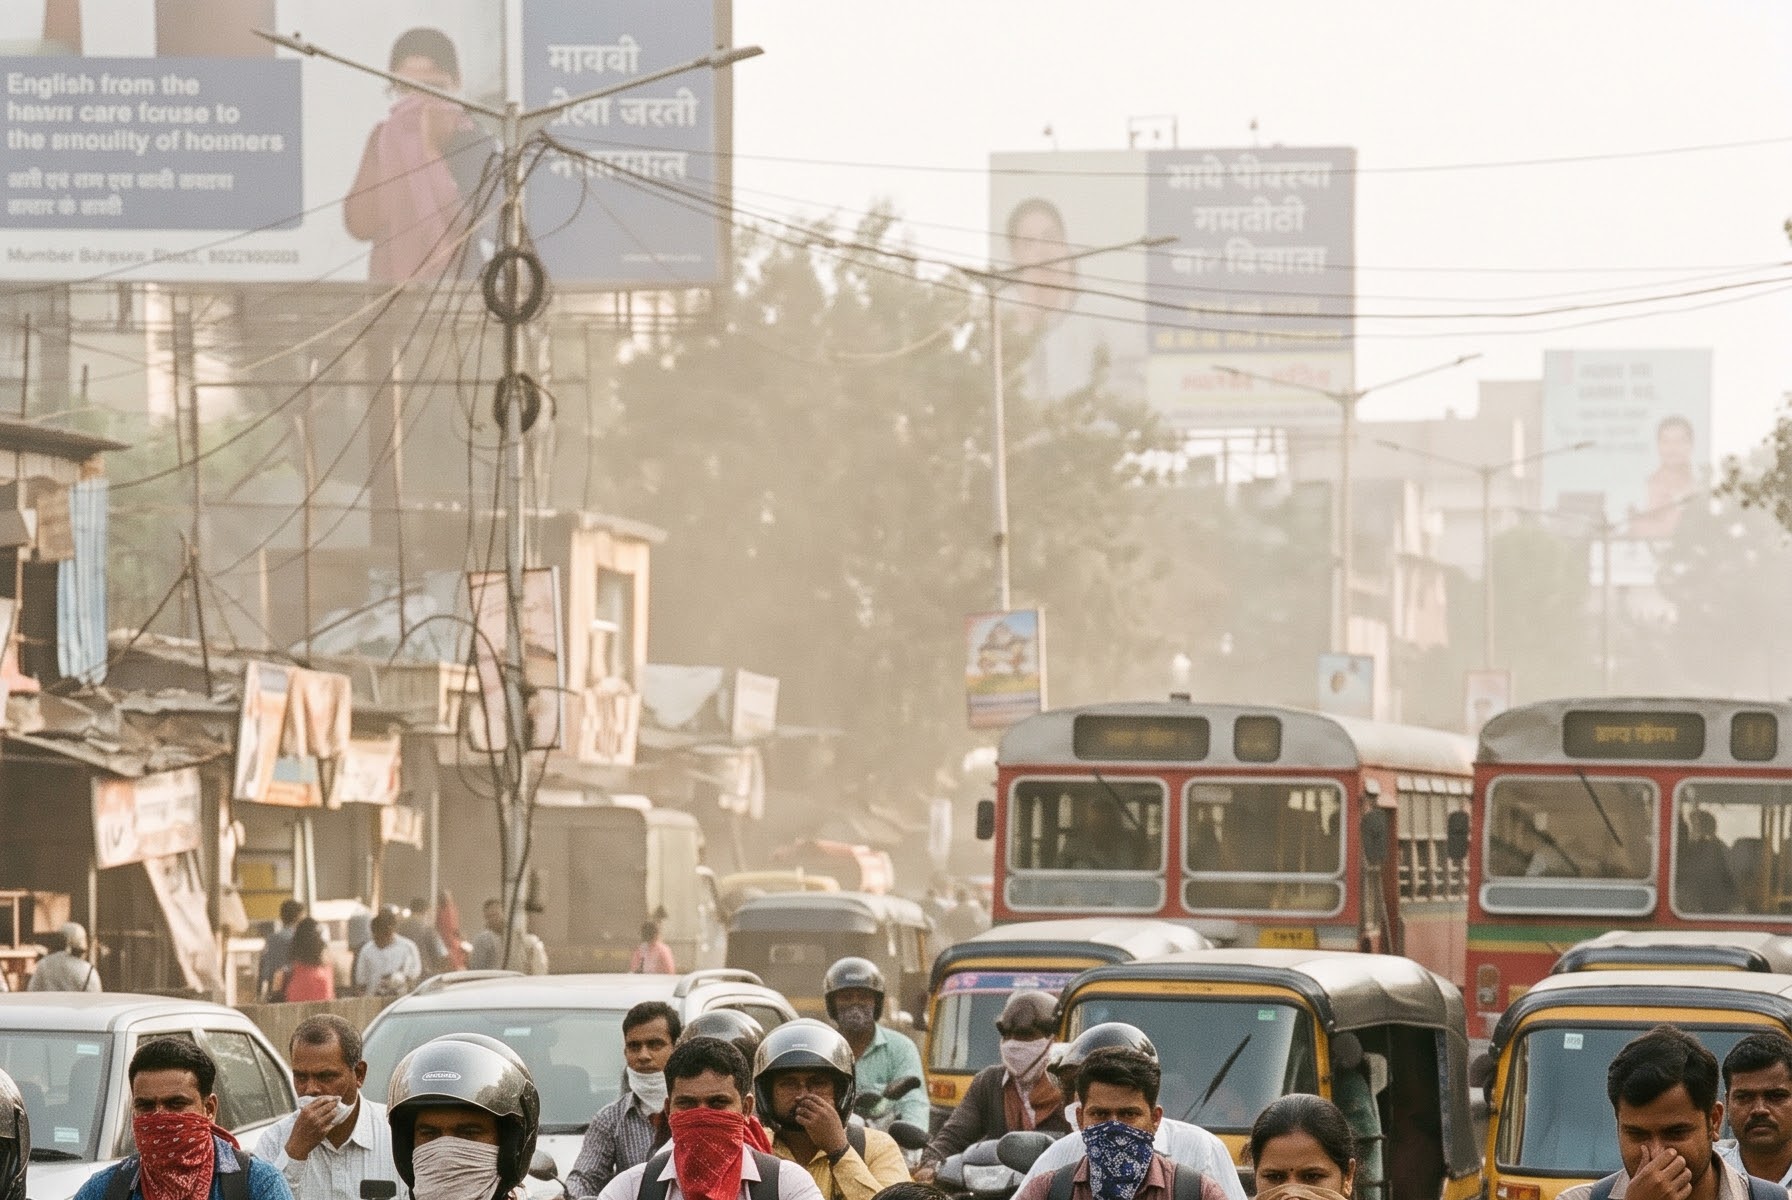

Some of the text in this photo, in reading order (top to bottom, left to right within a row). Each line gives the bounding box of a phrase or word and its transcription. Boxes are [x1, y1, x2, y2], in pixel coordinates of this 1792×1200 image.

[7, 72, 200, 99] English from the
[215, 103, 240, 123] to
[7, 130, 46, 150] the
[156, 130, 180, 150] of
